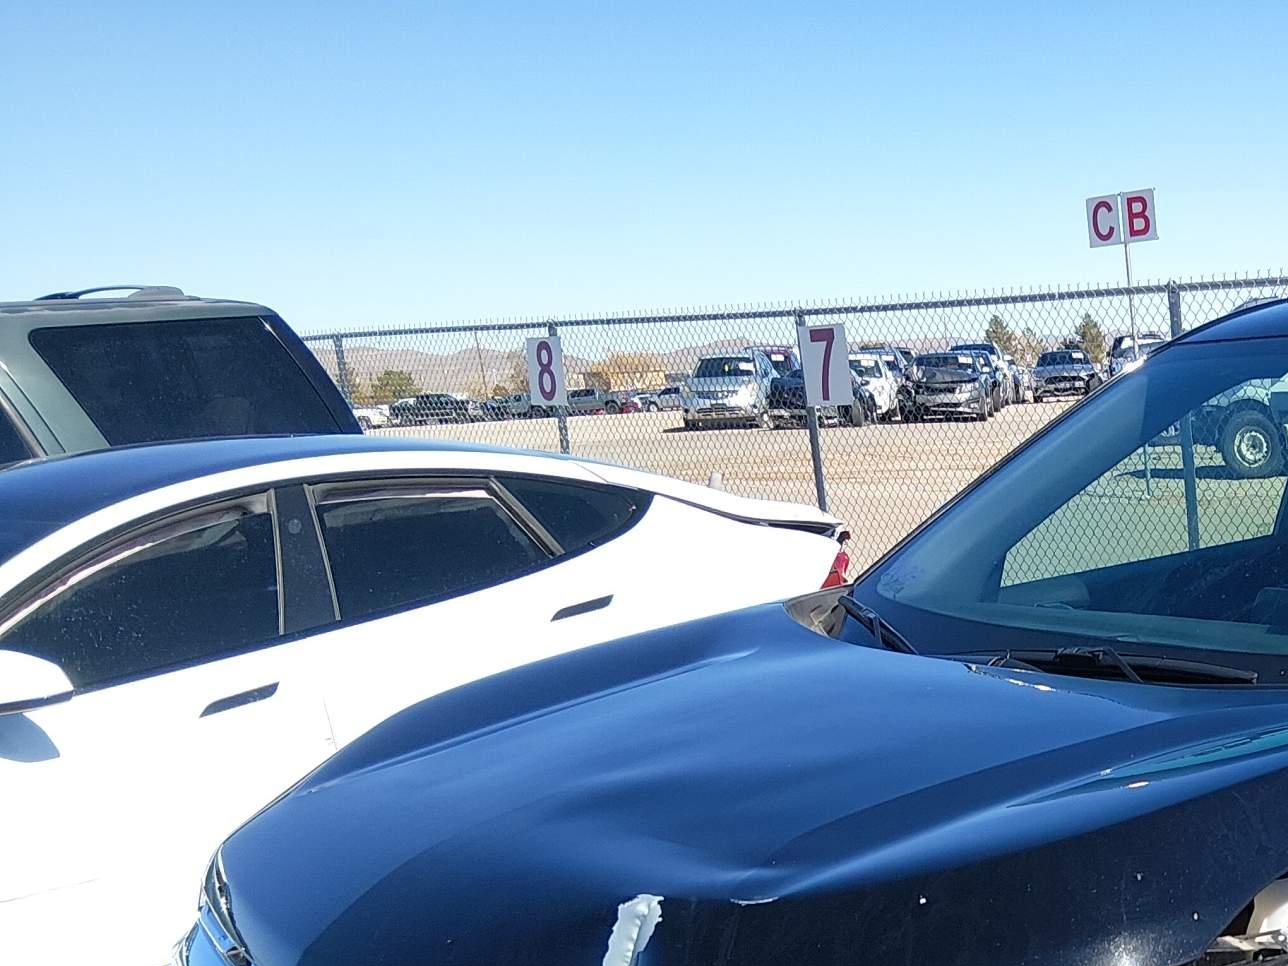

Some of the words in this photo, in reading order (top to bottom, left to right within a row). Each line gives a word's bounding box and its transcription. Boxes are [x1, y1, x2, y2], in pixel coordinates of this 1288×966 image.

[1092, 200, 1115, 241] C
[1127, 195, 1150, 238] B
[536, 340, 556, 401] 8
[809, 327, 835, 401] 7
